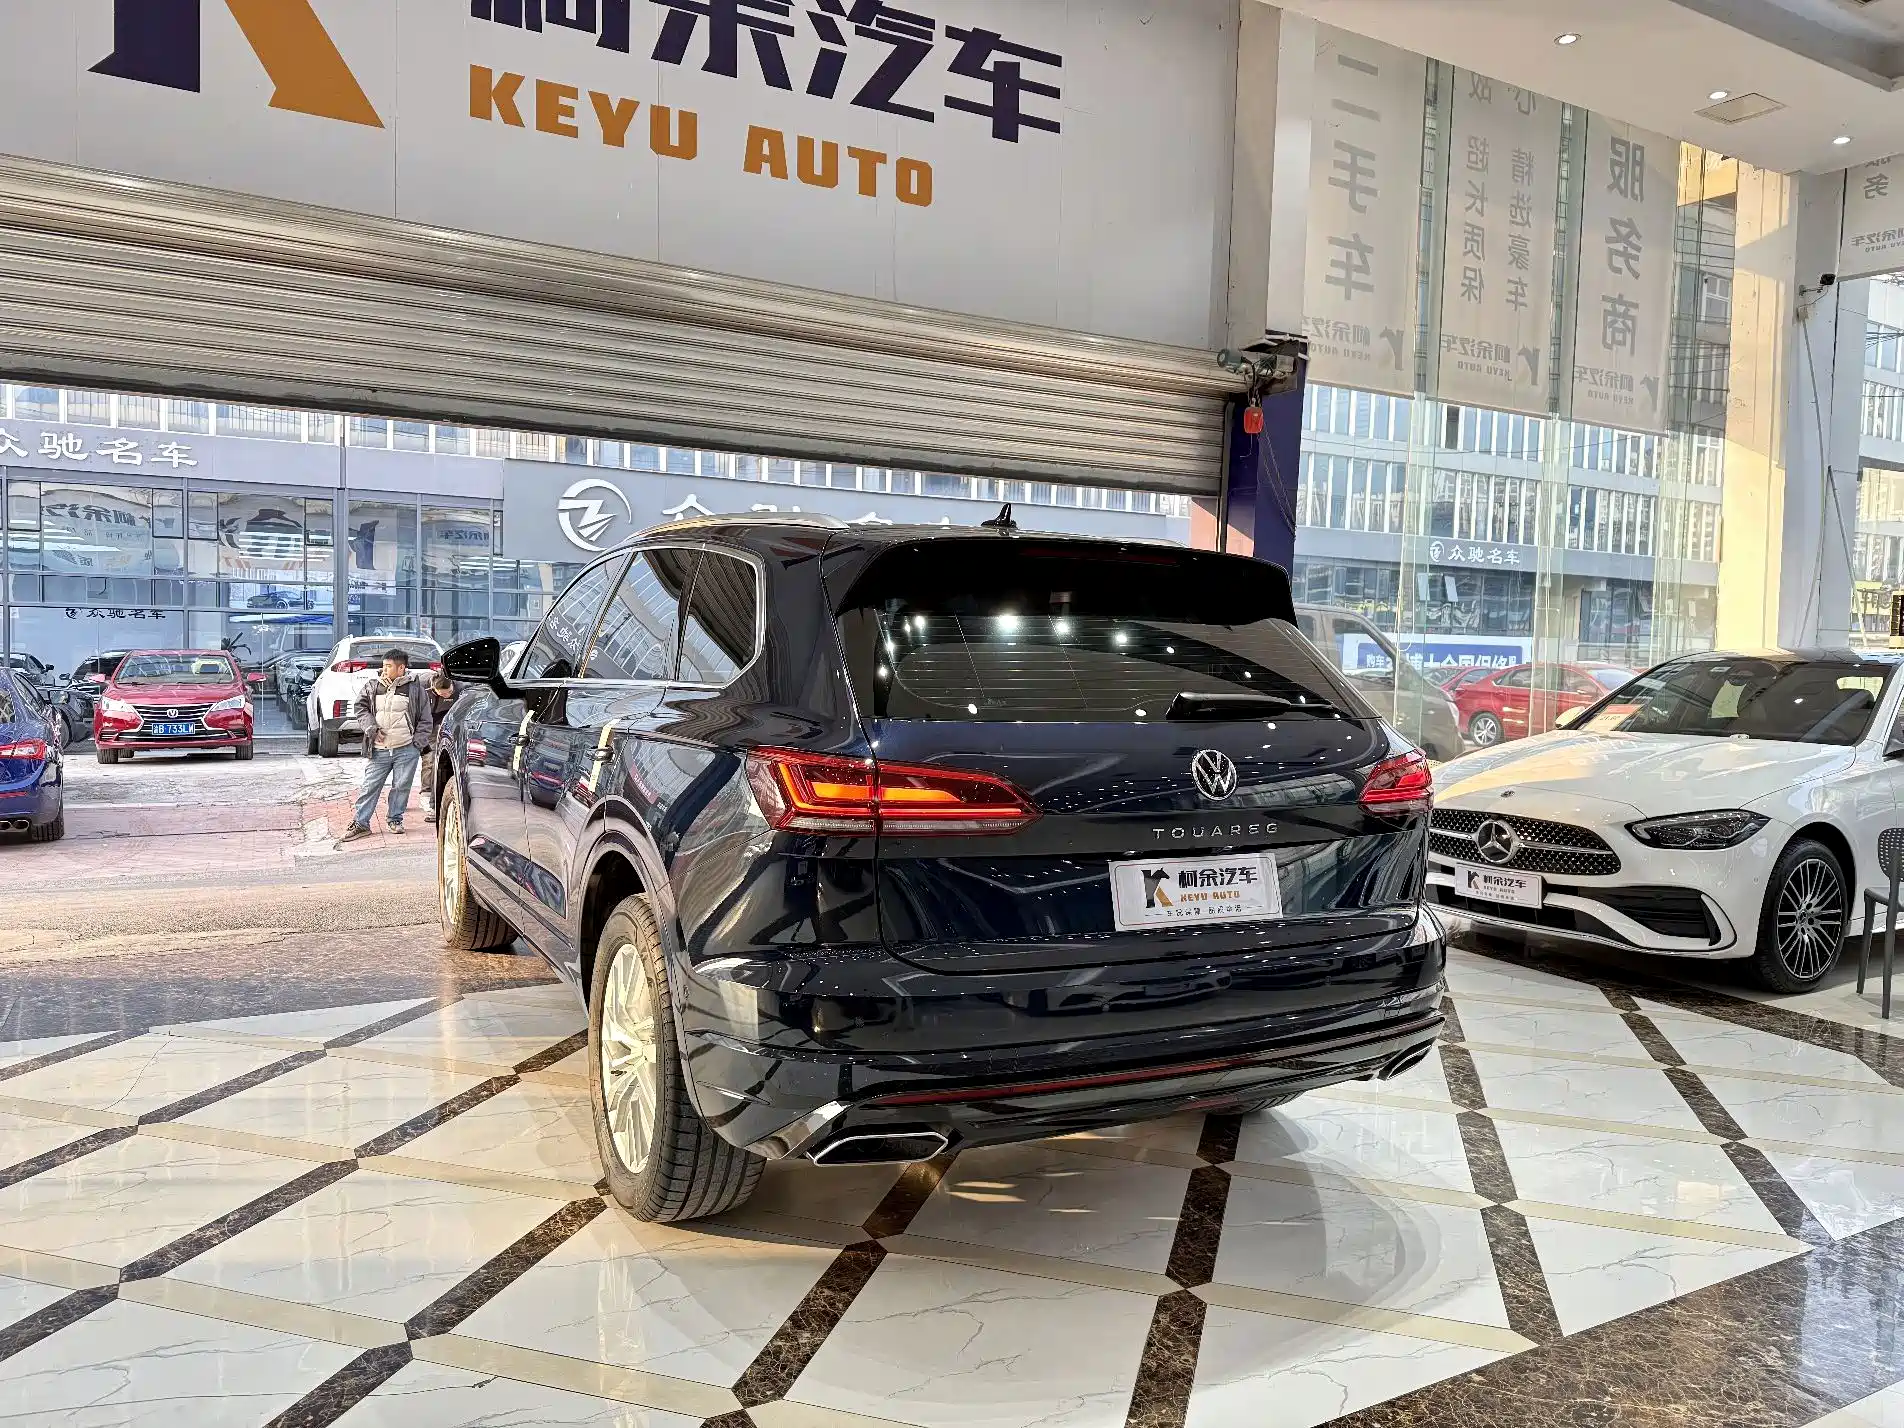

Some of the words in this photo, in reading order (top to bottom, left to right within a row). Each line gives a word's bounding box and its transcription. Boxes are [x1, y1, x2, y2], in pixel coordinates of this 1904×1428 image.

[469, 64, 698, 161] KEYU
[743, 125, 933, 207] AUTO
[1448, 545, 1520, 565] 众驰名车
[1152, 823, 1279, 840] TOUAREG
[1178, 867, 1258, 888] 柯余汽车
[1180, 893, 1208, 902] KEYU
